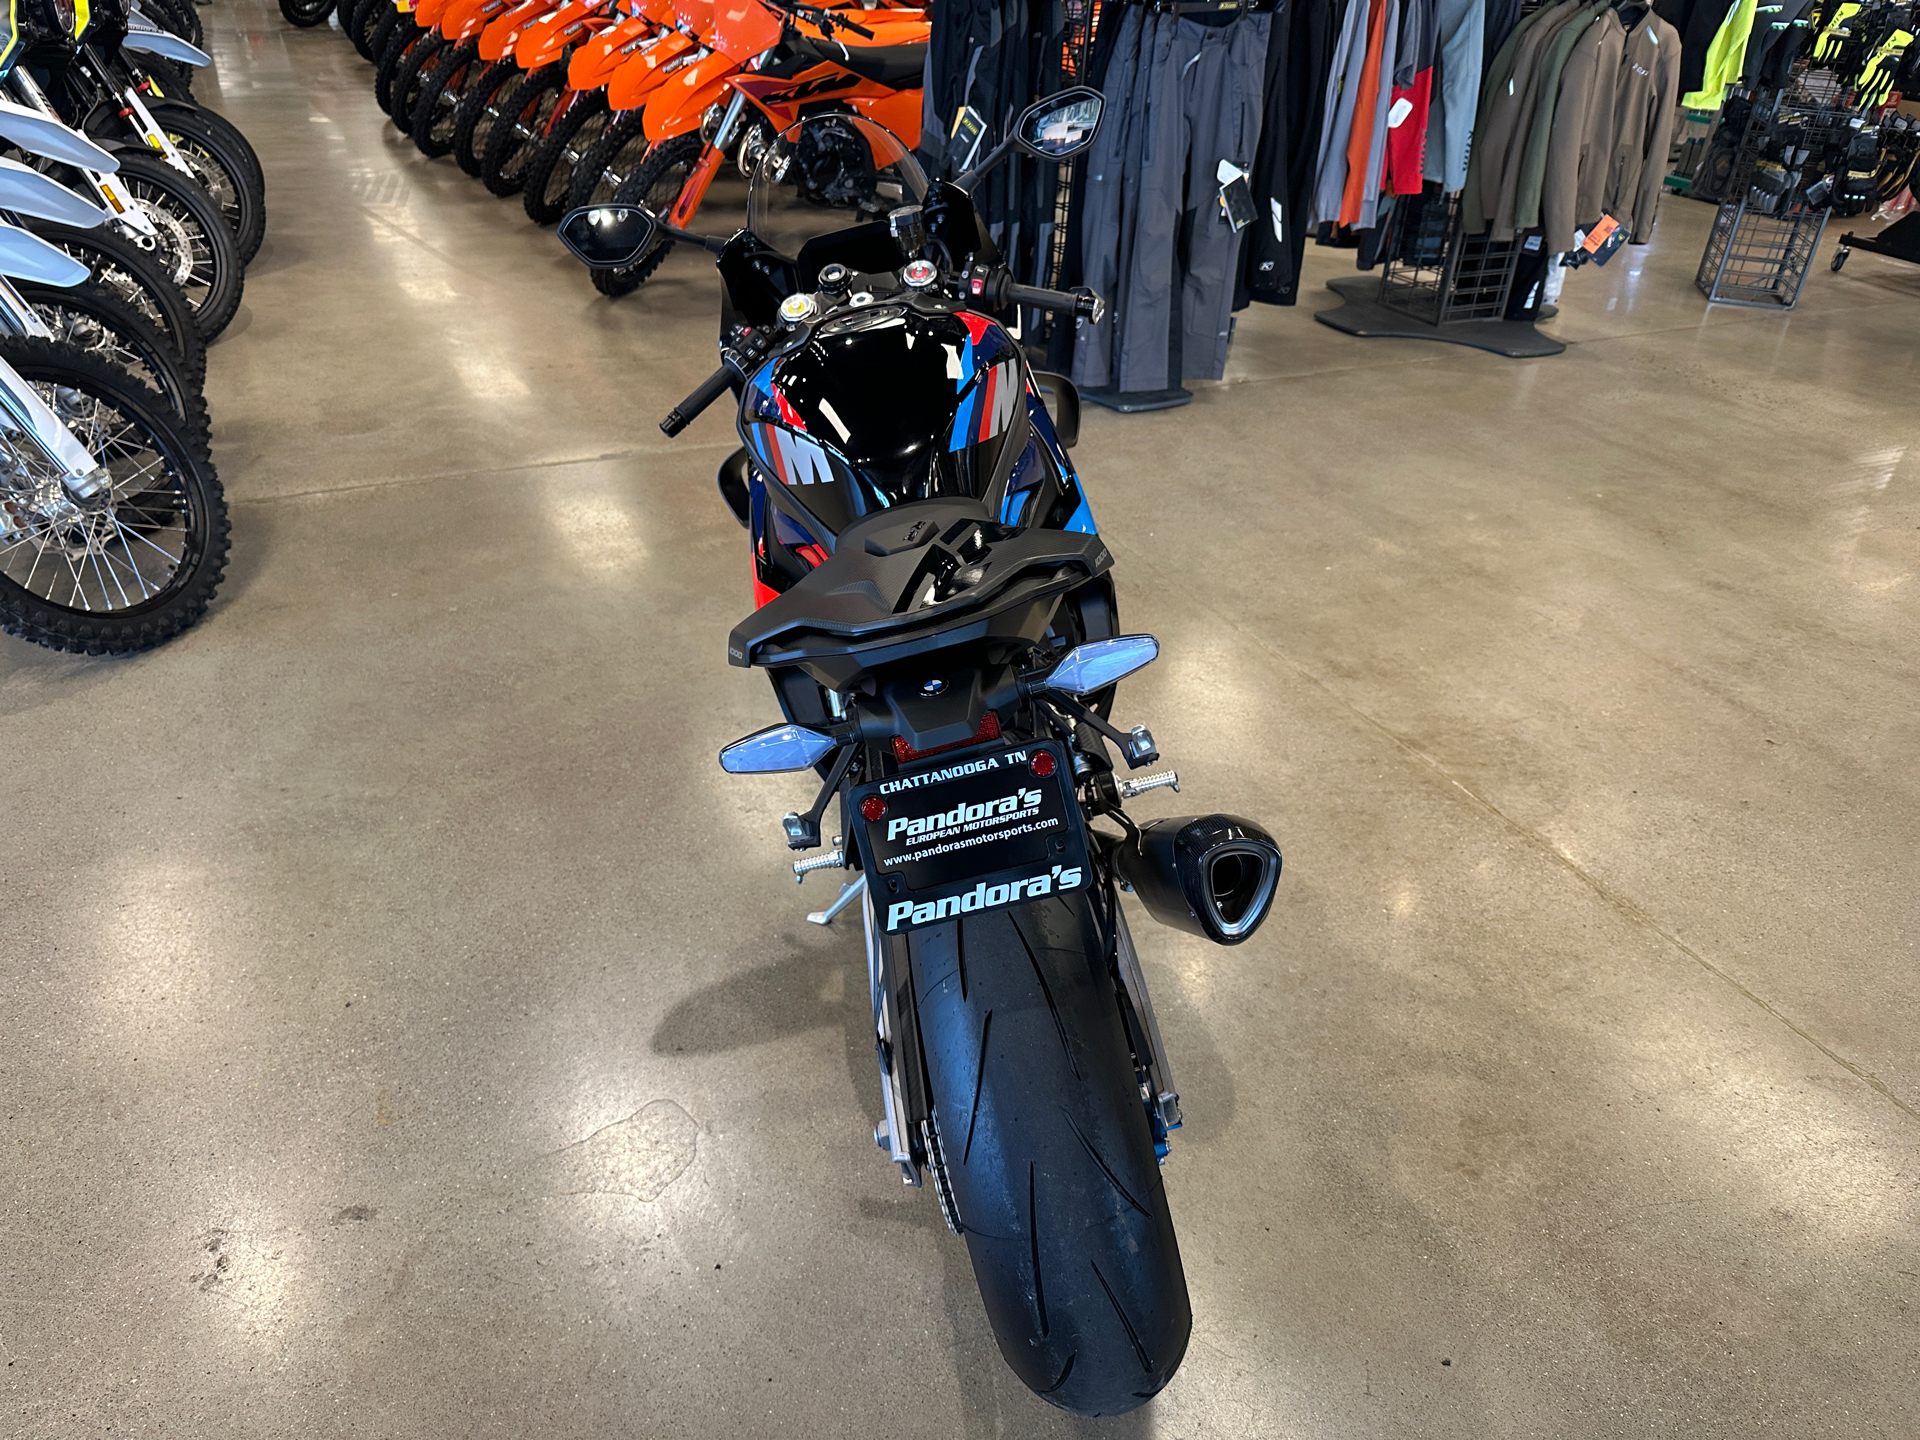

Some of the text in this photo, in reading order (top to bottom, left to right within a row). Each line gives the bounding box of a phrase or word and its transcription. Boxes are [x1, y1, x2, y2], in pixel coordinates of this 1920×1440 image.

[760, 71, 862, 105] KTM
[774, 423, 835, 485] M
[1094, 547, 1108, 568] 1000
[729, 646, 743, 660] 1000
[879, 750, 1027, 795] CHATTANOOGA TN
[886, 787, 1042, 842] Pandora's
[905, 806, 1040, 847] EUROPEAN MOTORSPORTS
[883, 816, 1059, 867] www.pandorasmotorsports.com
[886, 864, 1082, 932] Pandora's
